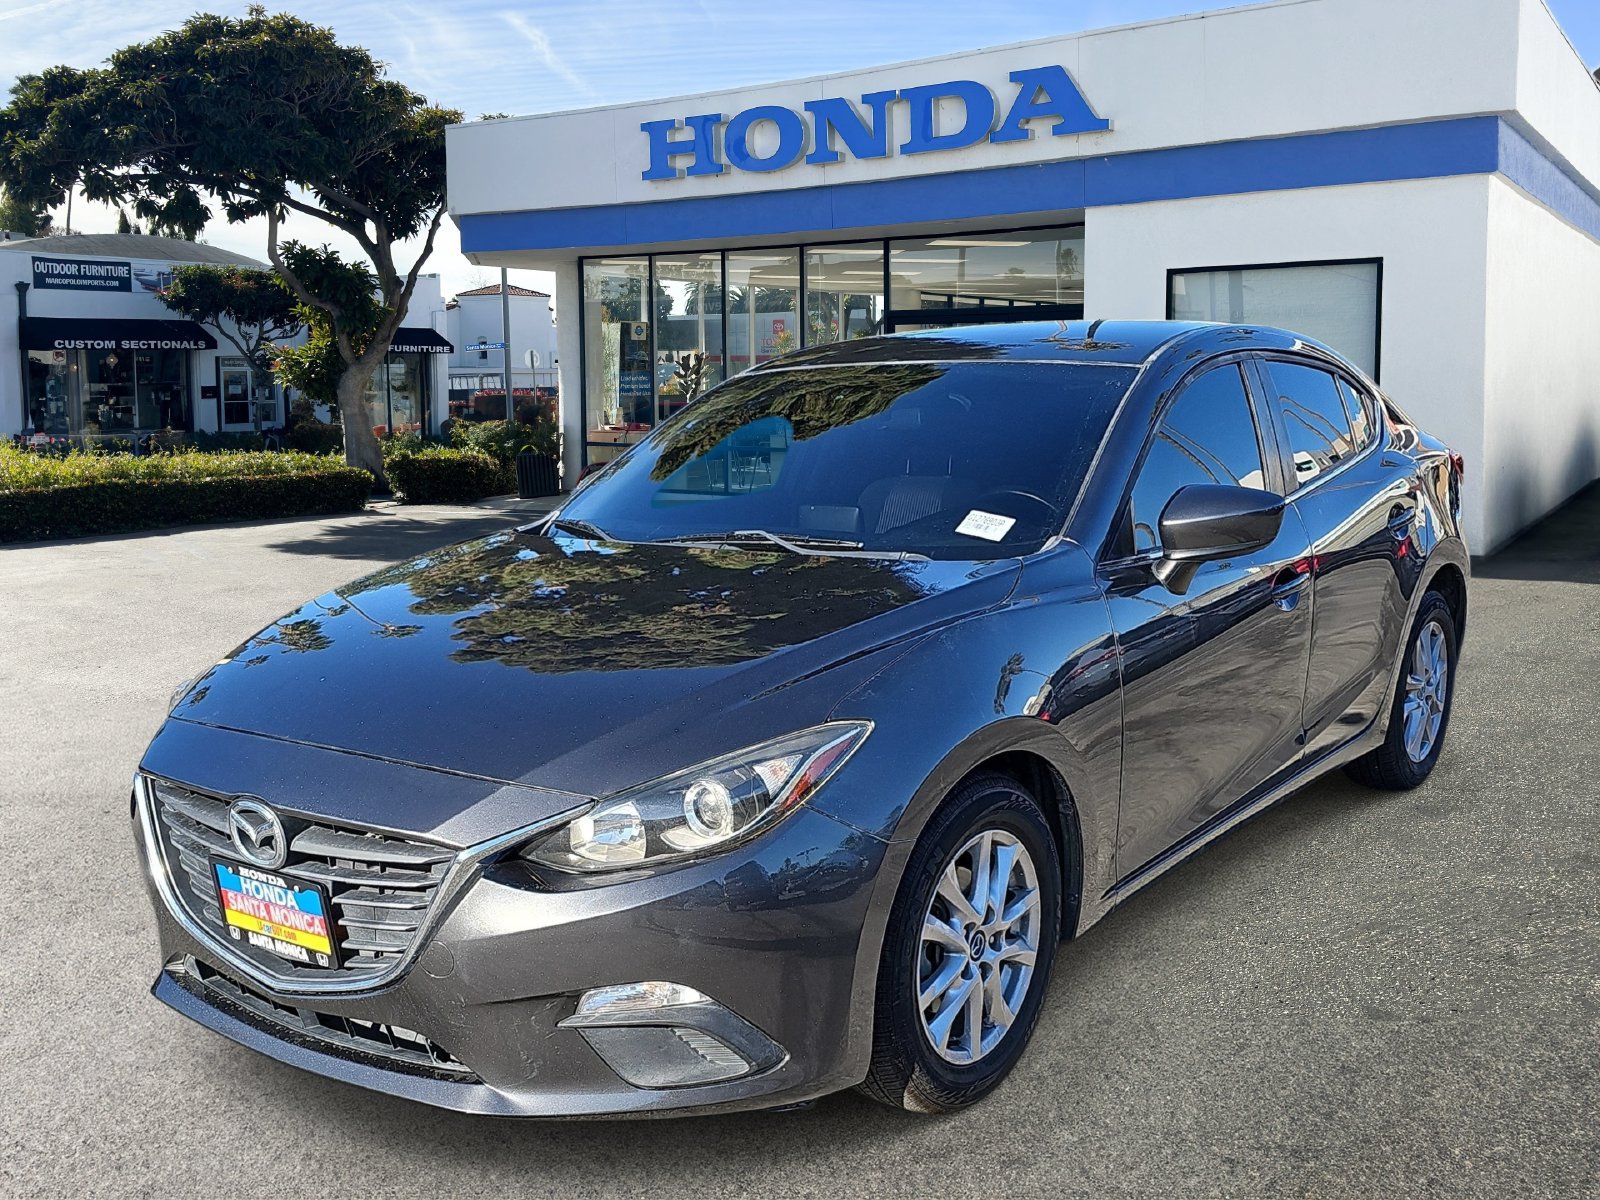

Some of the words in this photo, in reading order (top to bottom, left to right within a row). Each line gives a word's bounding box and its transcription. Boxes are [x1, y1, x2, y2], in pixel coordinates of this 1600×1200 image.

[641, 64, 1111, 181] HONDA
[34, 261, 79, 275] OUTDOOR
[80, 265, 129, 278] FURNITURE
[45, 278, 119, 287] MARCOPOLOIMPORTS.COM
[54, 340, 116, 349] CUSTOM
[121, 340, 206, 349] SECTIONALS
[388, 345, 451, 353] FURNITURE
[238, 866, 288, 888] HONDA
[240, 877, 300, 911] HONDA
[227, 892, 269, 921] SANTA
[271, 905, 325, 937] MONICA
[248, 932, 275, 950] SANTA
[275, 939, 310, 962] MONICA
